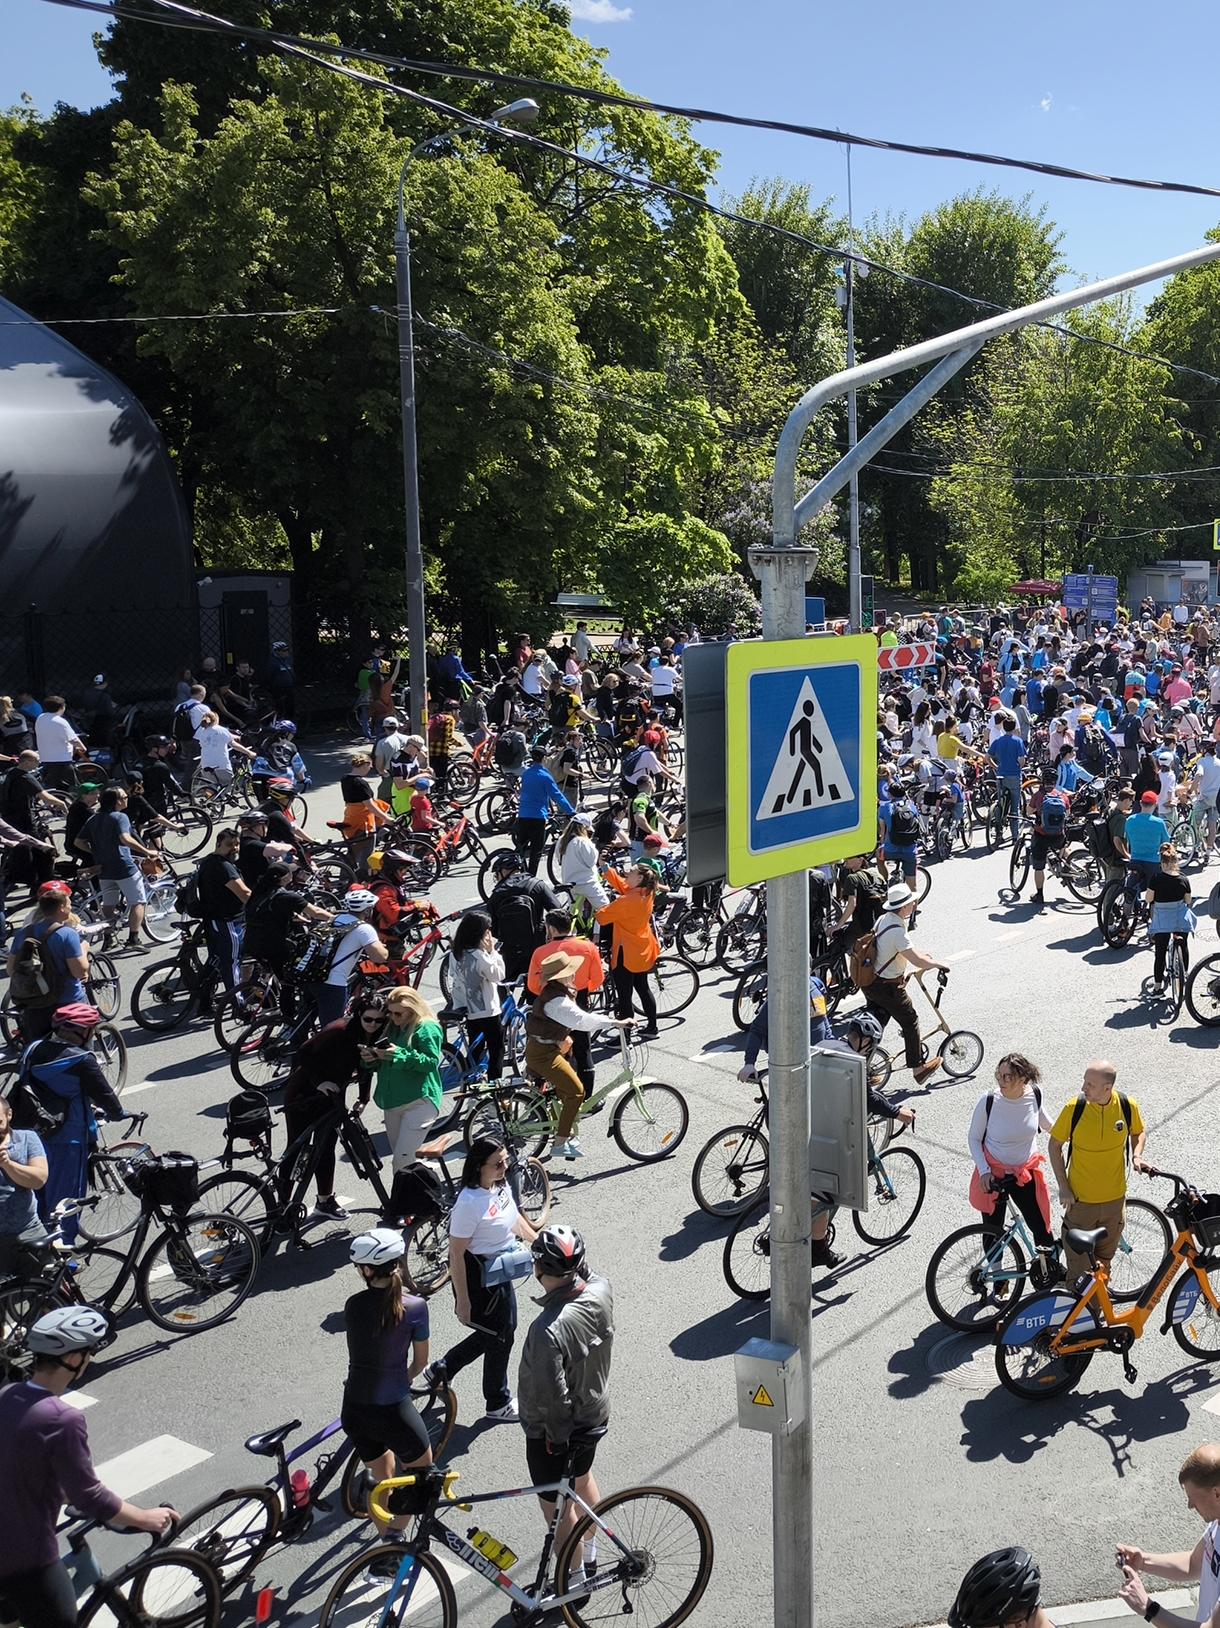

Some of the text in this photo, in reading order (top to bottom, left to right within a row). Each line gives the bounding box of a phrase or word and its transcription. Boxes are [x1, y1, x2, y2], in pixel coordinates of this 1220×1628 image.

[1151, 1260, 1183, 1304] Велобайк
[1185, 1290, 1198, 1298] ВТБ
[1026, 1315, 1046, 1329] ВТБ
